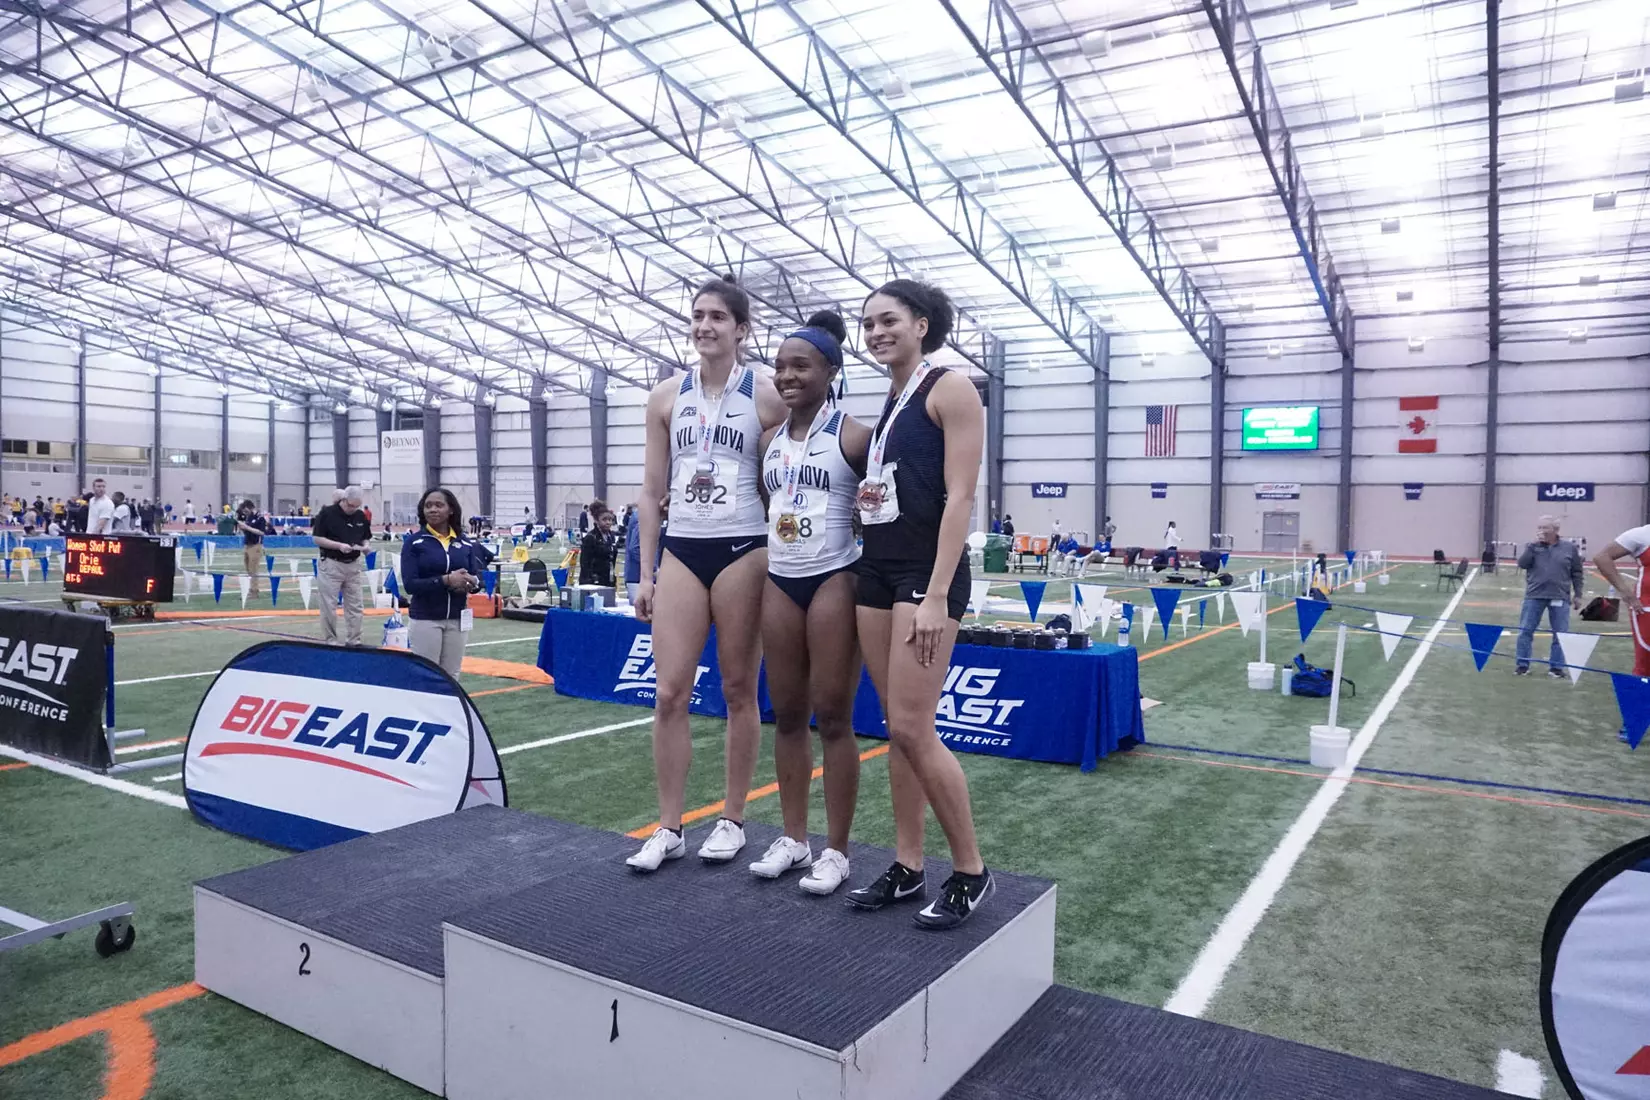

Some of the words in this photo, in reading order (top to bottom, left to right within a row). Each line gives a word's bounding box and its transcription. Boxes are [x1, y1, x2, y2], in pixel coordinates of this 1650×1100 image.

[676, 424, 744, 453] VILNOVA
[764, 464, 831, 492] VILNOVA
[1036, 484, 1063, 496] Jeep
[1545, 484, 1586, 499] Jeep
[79, 552, 99, 565] Orie
[89, 540, 105, 553] Shot
[108, 541, 121, 554] Put
[79, 565, 104, 575] DEPAUL
[146, 579, 154, 593] F
[618, 658, 711, 687] EAT
[942, 665, 1001, 696] IG
[0, 695, 68, 721] ONFERENCE
[935, 694, 1025, 725] AST
[936, 731, 1012, 746] NFERENCE
[299, 942, 311, 976] 2
[610, 998, 619, 1042] 1
